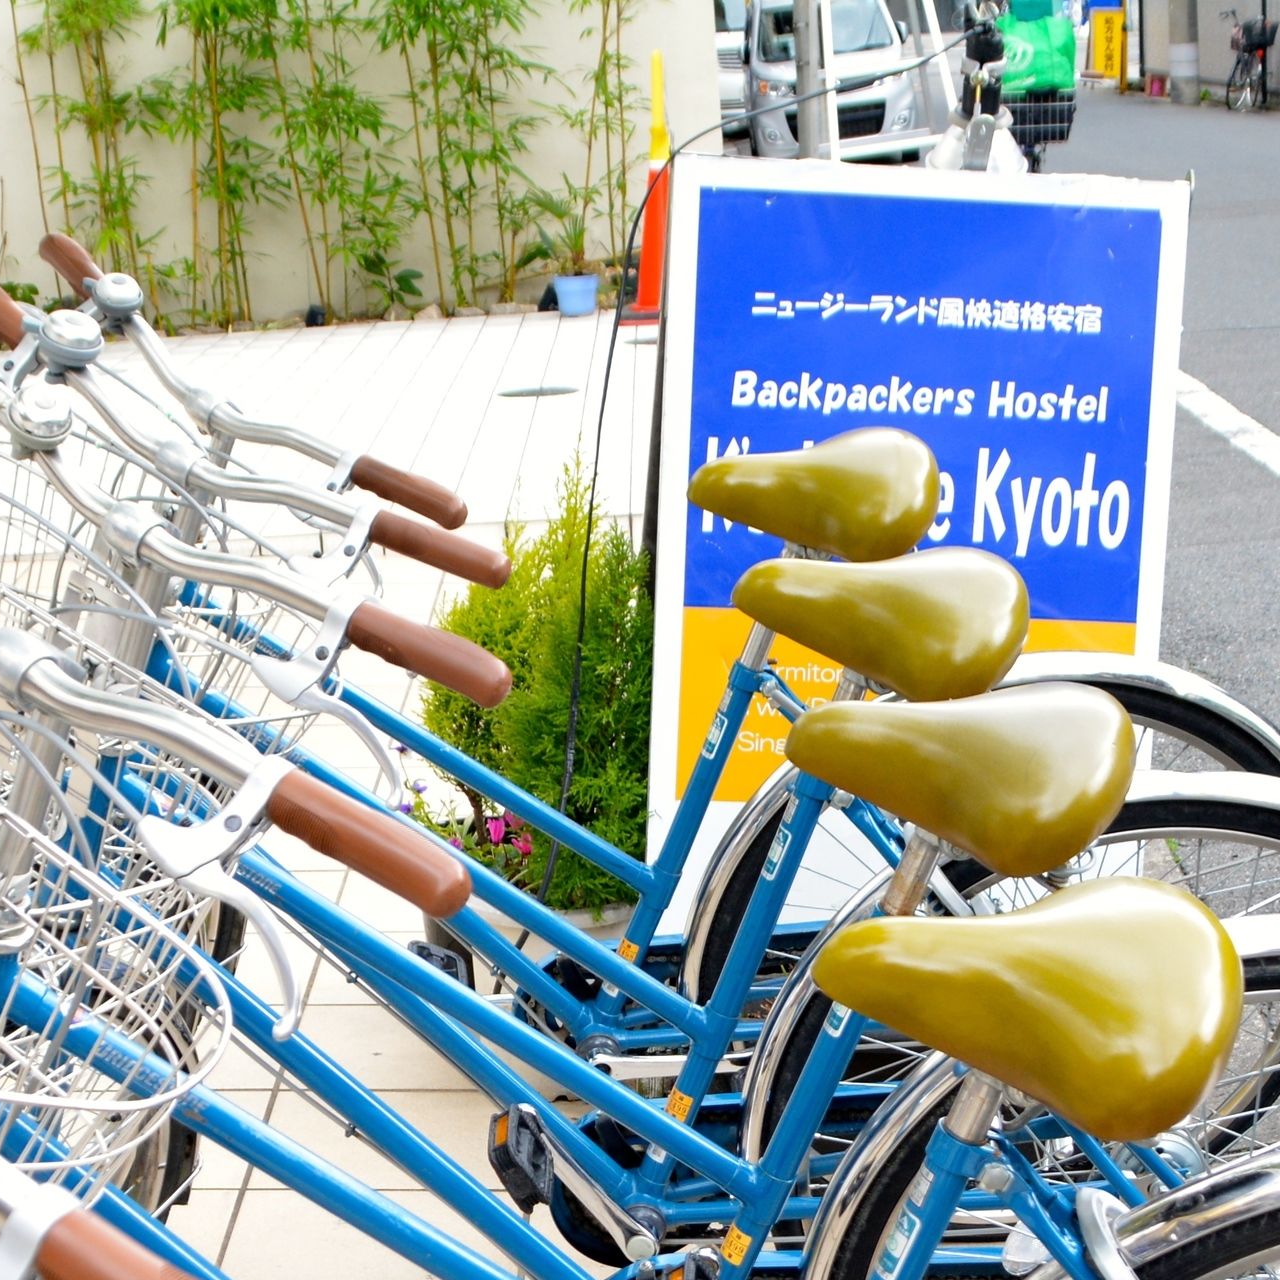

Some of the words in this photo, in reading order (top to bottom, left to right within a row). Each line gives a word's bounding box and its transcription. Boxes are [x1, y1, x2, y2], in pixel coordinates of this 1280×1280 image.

[751, 290, 1103, 335] ニュージーランド風快適格安宿
[731, 369, 975, 418] Backpackers
[987, 380, 1110, 422] Hostel
[971, 447, 1130, 557] Kyoto
